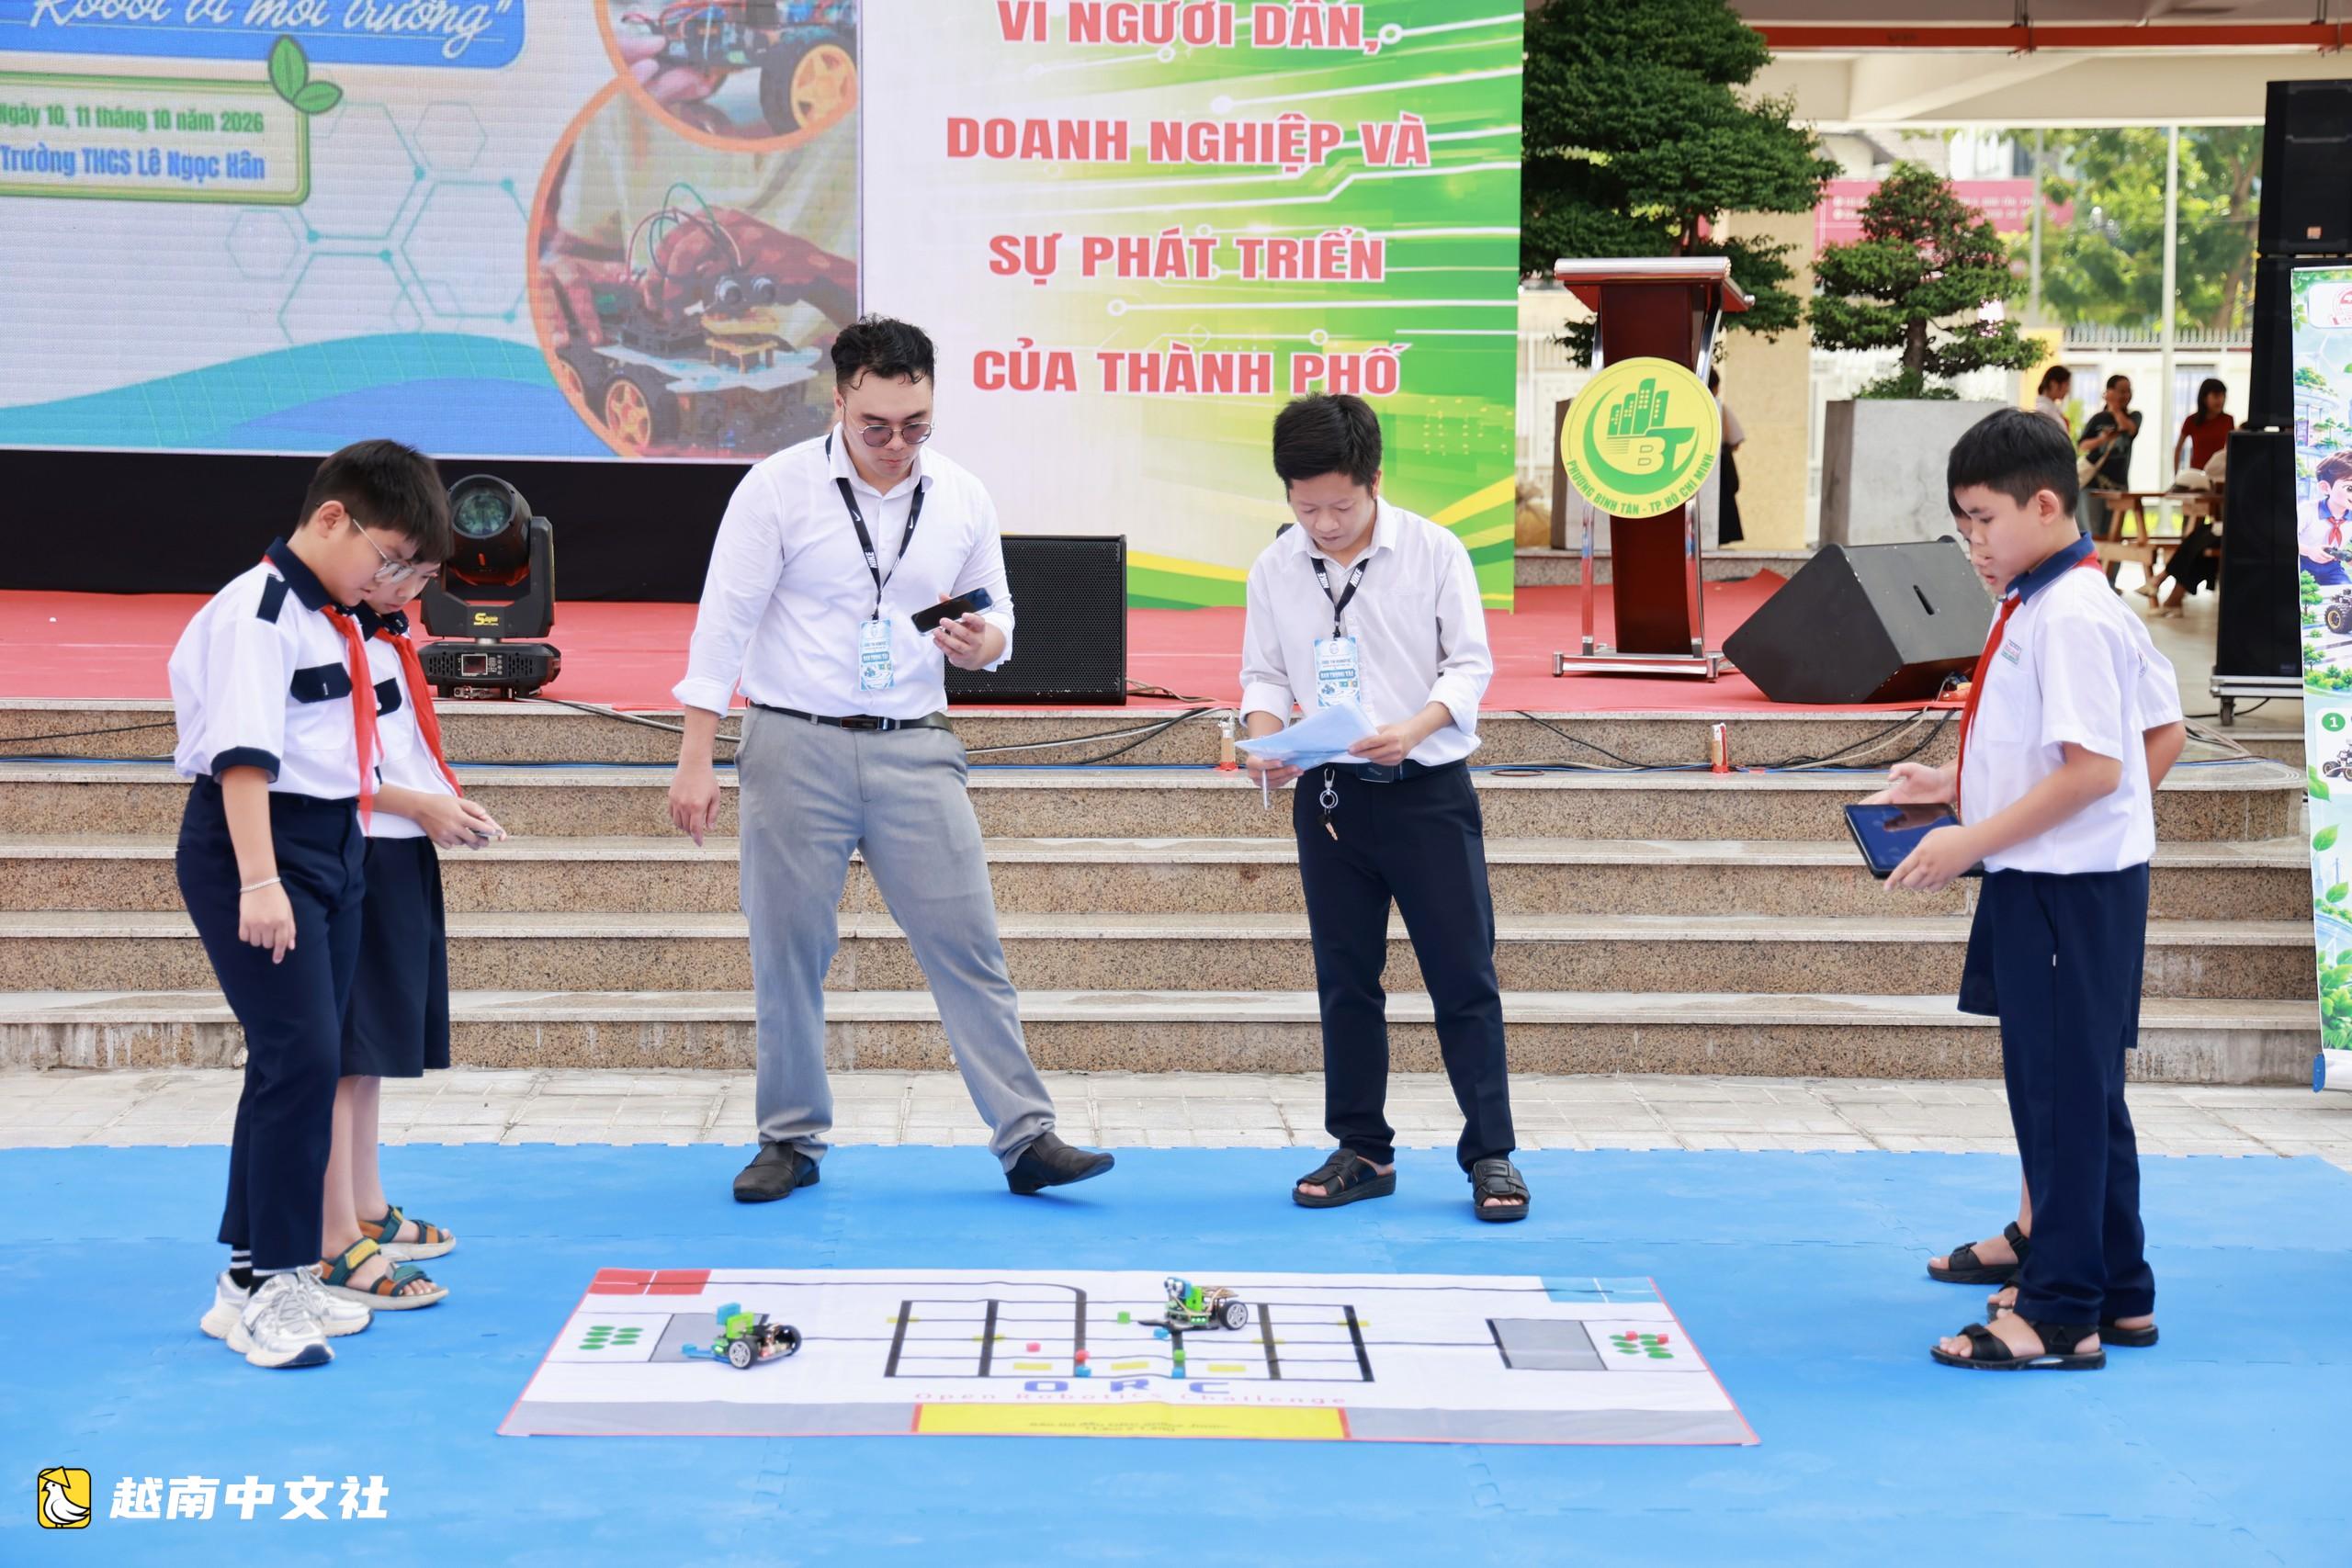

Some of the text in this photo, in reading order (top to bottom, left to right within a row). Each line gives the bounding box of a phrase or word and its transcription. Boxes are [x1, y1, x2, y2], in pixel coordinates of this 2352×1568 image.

[47, 104, 70, 130] 10,
[75, 106, 90, 127] 11
[96, 106, 147, 131] tháng
[153, 108, 171, 130] 10
[176, 107, 215, 131] năm
[220, 111, 264, 132] 2026
[946, 113, 1429, 173] DOANH NGHIỆP VÀ
[0, 141, 266, 184] Trường THCS Lê Ngọc Hân
[989, 226, 1384, 286] SỰ PHÁT TRIỂN
[972, 337, 1412, 395] CỦA THÀNH PHỐ
[1349, 567, 1363, 589] NIKE
